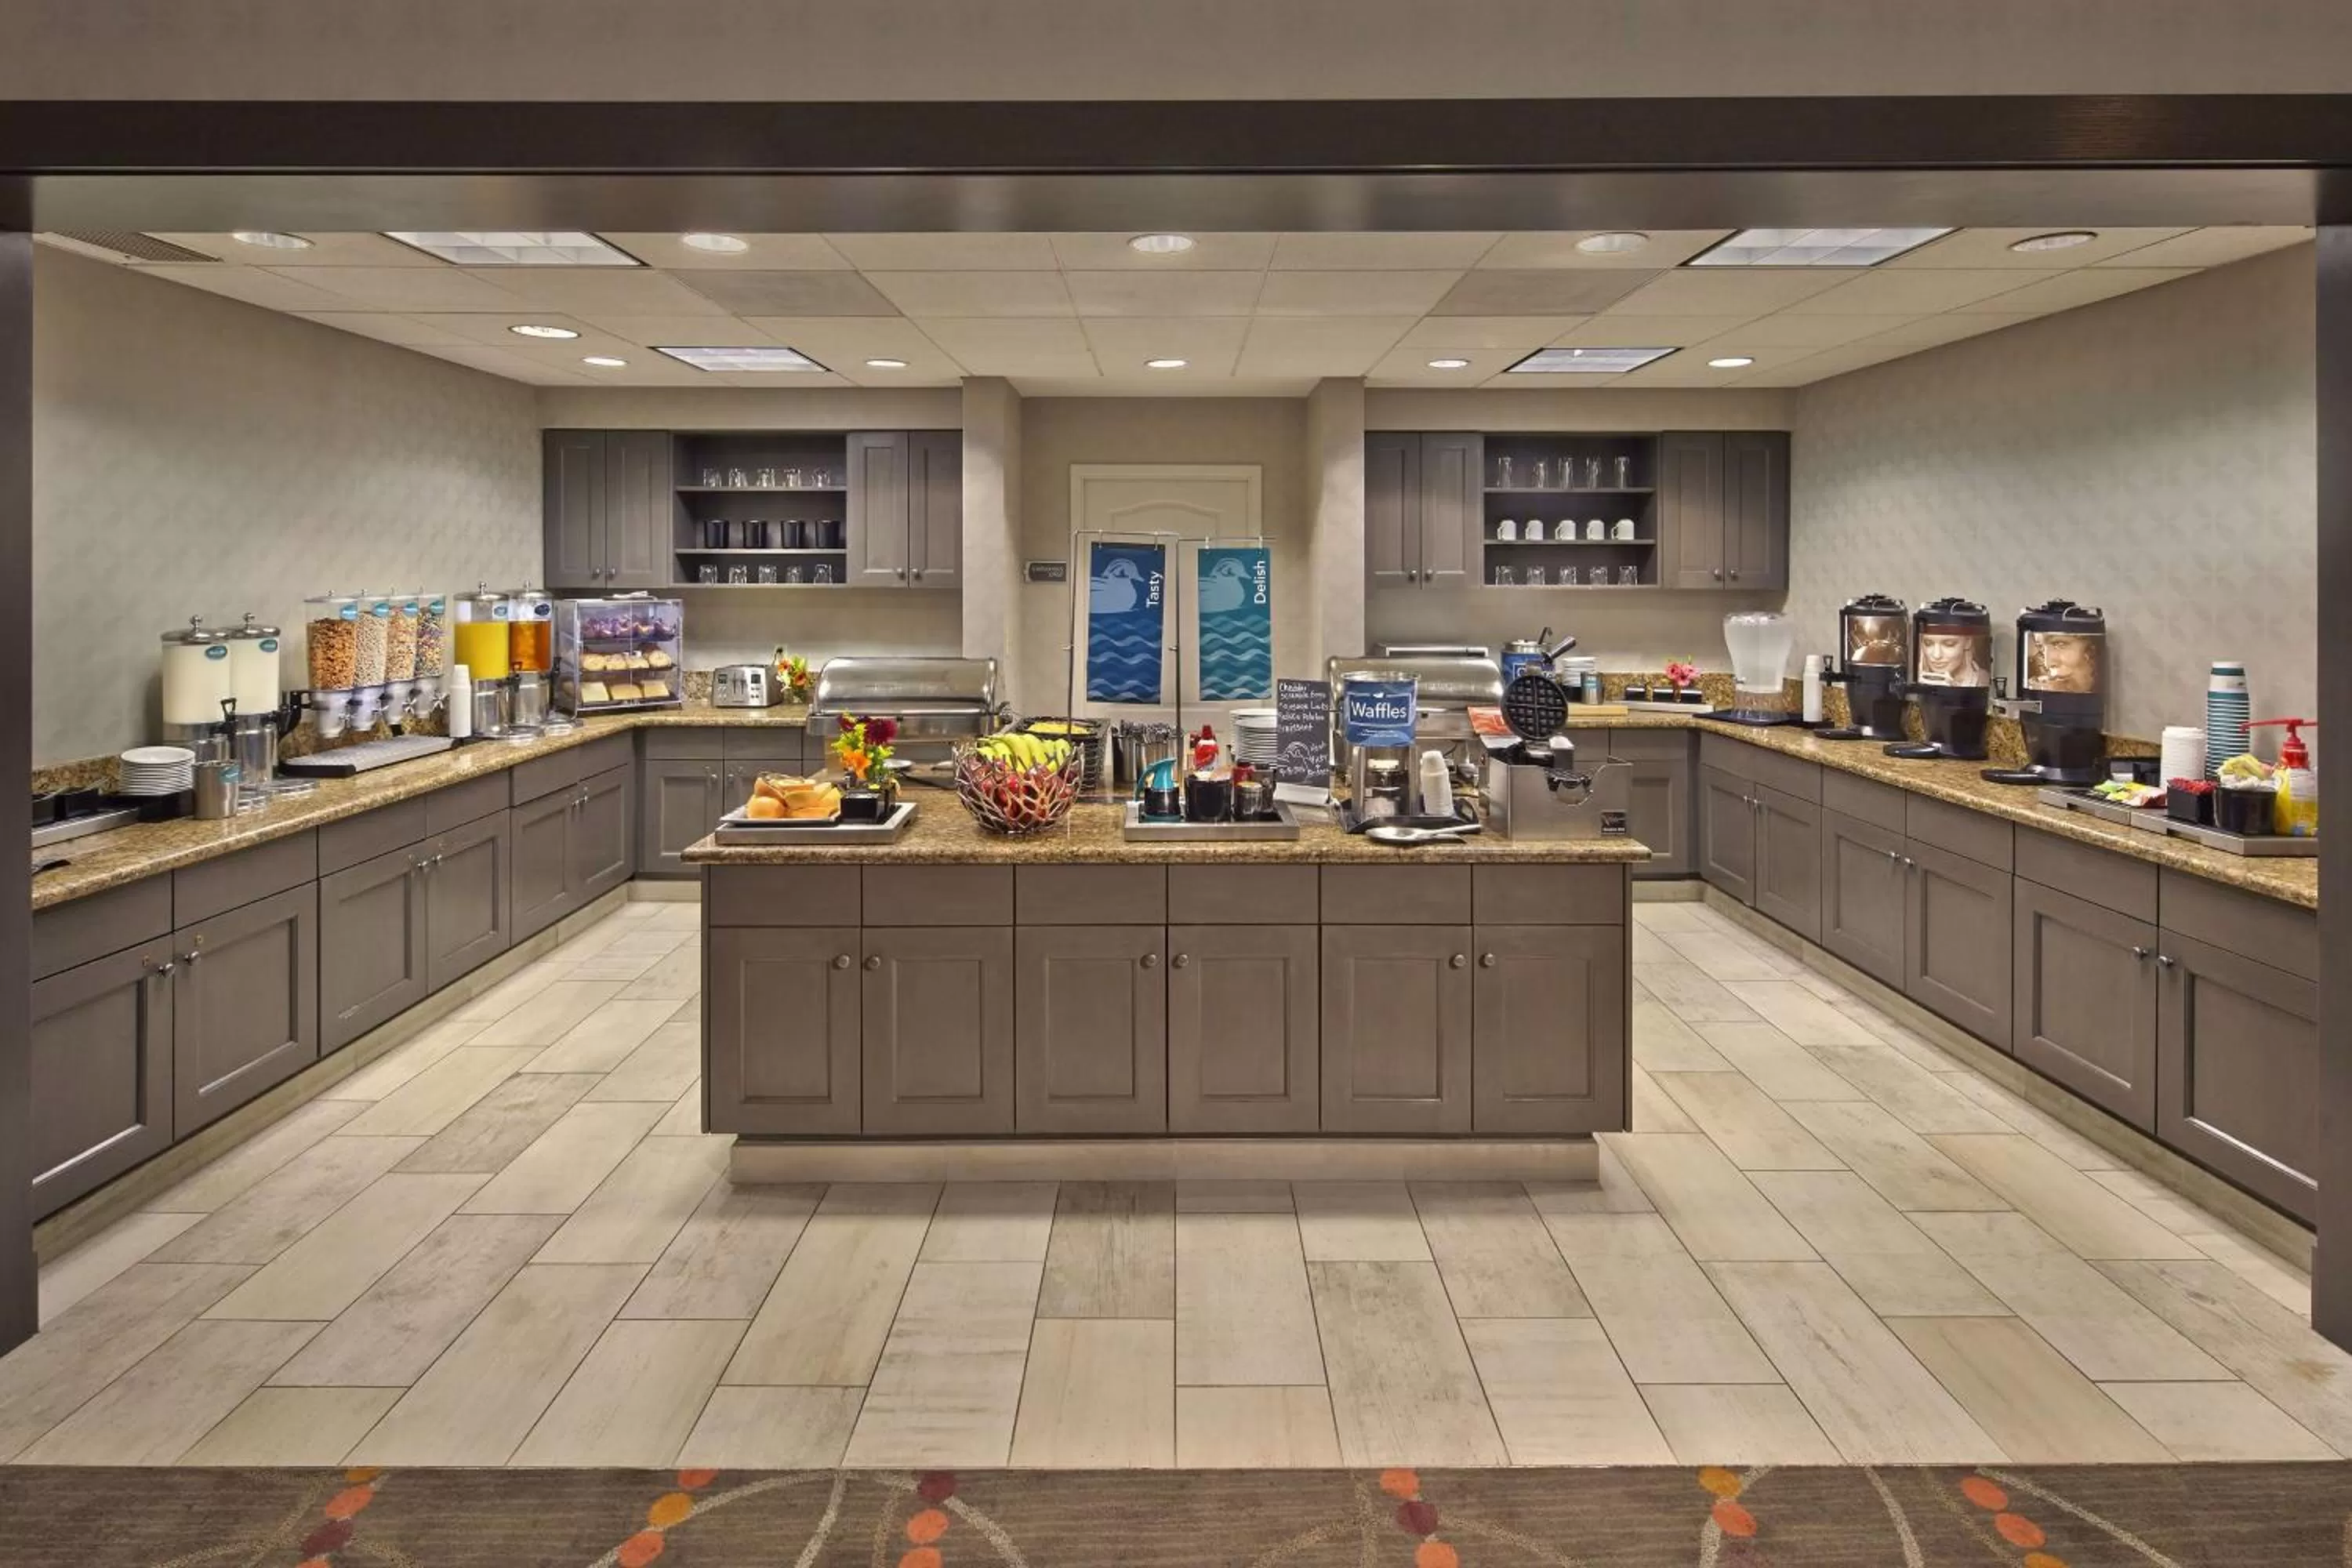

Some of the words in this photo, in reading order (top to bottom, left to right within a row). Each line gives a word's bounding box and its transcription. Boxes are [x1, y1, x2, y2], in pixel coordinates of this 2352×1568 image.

[1145, 570, 1163, 608] Tasty
[1253, 560, 1266, 604] Delish
[1351, 699, 1407, 719] Waffles
